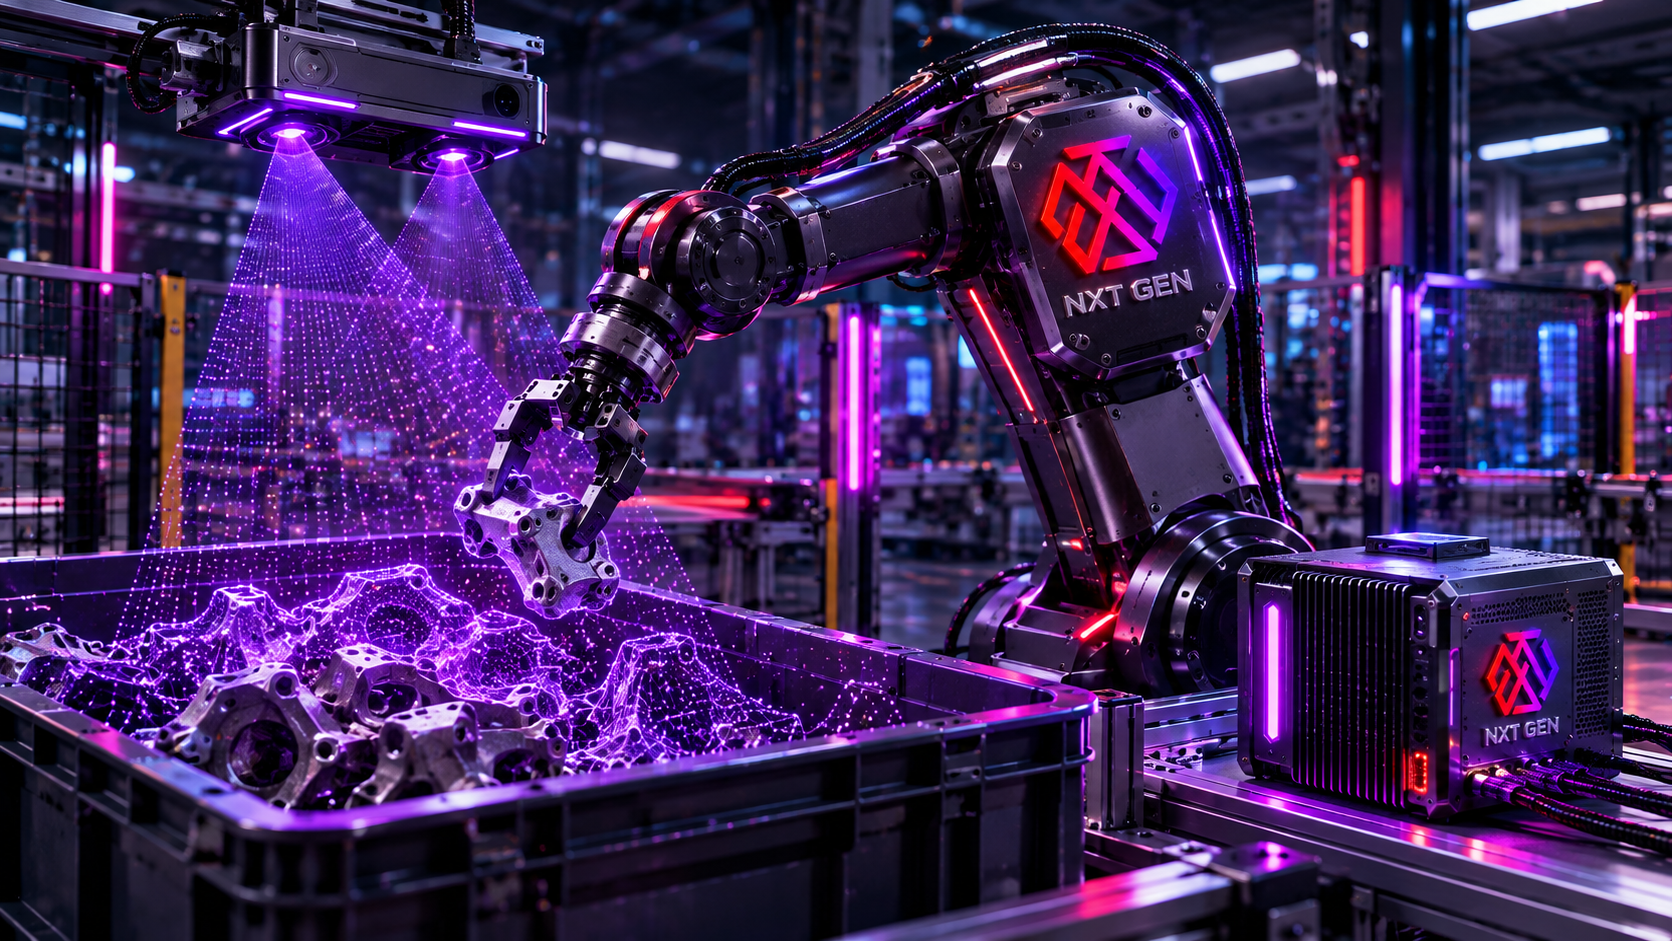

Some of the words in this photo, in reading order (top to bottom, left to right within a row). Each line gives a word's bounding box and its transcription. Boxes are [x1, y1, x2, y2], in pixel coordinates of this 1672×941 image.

[1062, 284, 1123, 318] NXT
[1130, 269, 1193, 301] GEN
[1485, 723, 1520, 746] NXT
[1524, 716, 1559, 738] GEN
